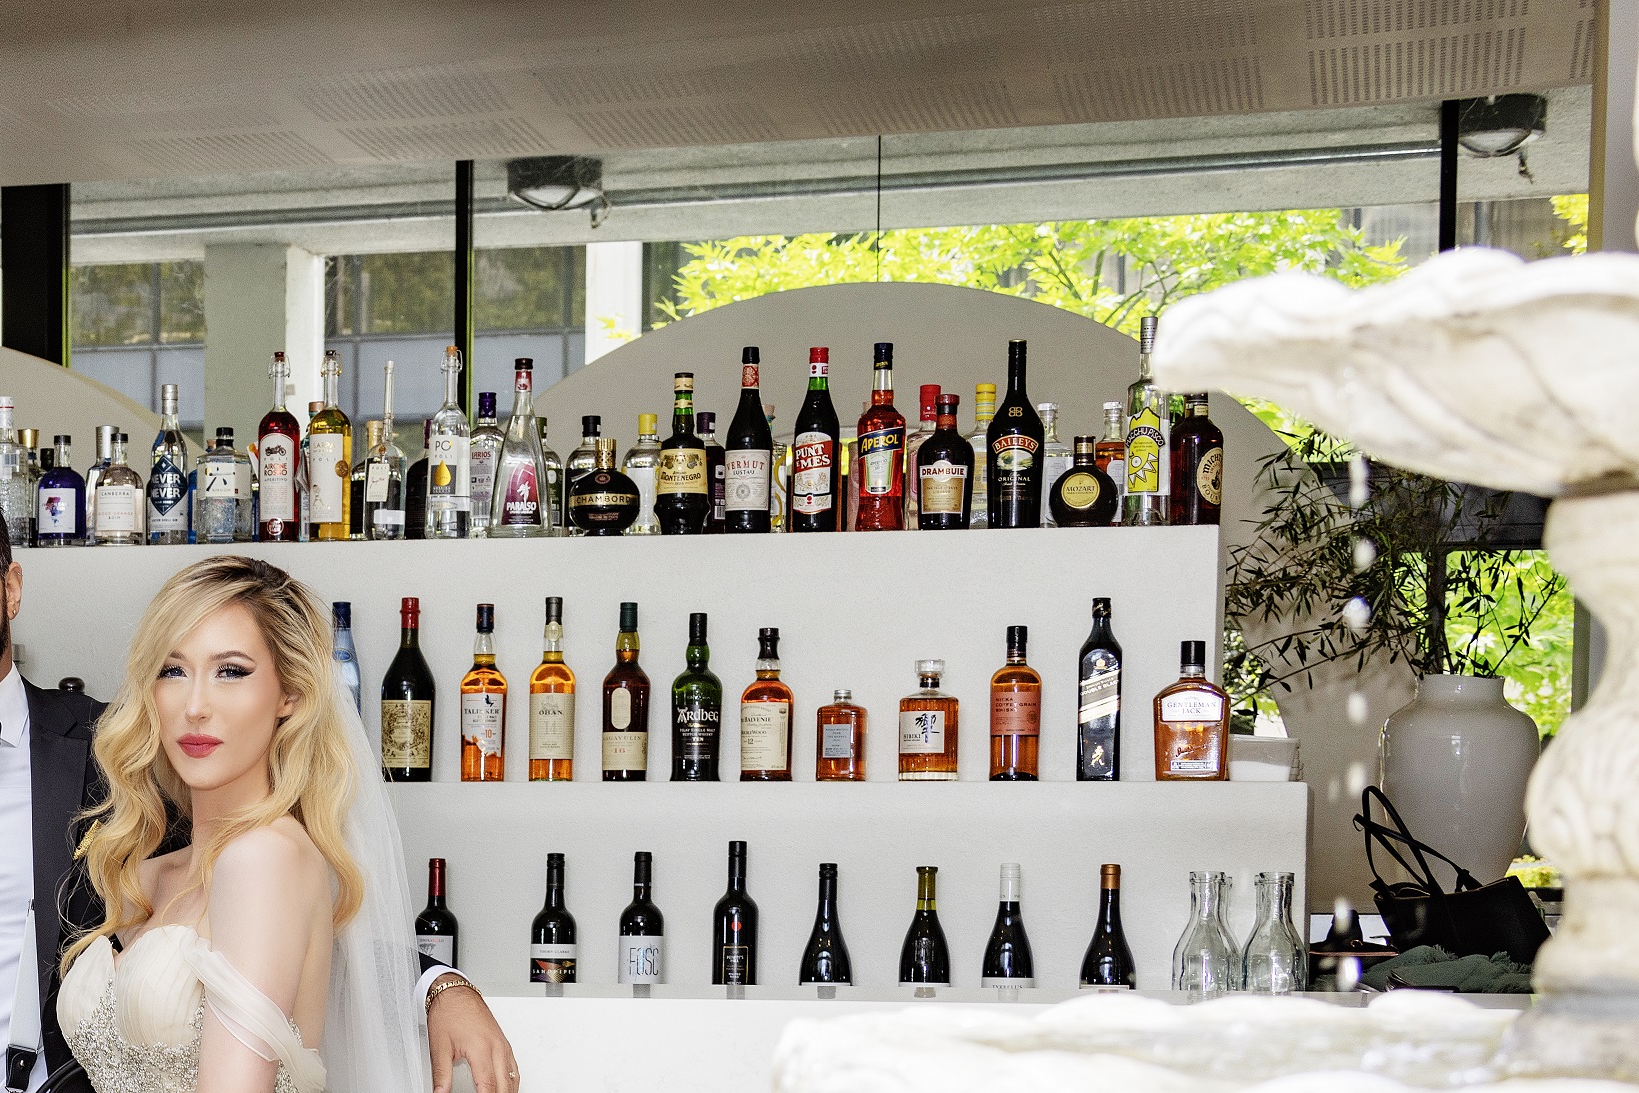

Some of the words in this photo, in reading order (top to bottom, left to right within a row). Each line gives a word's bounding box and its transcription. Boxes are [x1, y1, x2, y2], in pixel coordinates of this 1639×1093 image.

[861, 434, 899, 453] APEROL
[994, 438, 1036, 450] BAILEYS
[471, 451, 491, 460] LARIOS
[795, 444, 825, 460] PUNT
[726, 460, 765, 471] VERMUT
[800, 455, 831, 469] MES
[661, 472, 702, 482] MONTENEGRO
[921, 467, 965, 476] DRAMBUIE
[151, 473, 181, 484] NEVER
[151, 488, 181, 498] NEVER
[576, 495, 631, 504] CHAMBORD
[1080, 685, 1102, 696] DOUBLE
[484, 729, 493, 738] 10
[629, 947, 659, 976] FOSC
